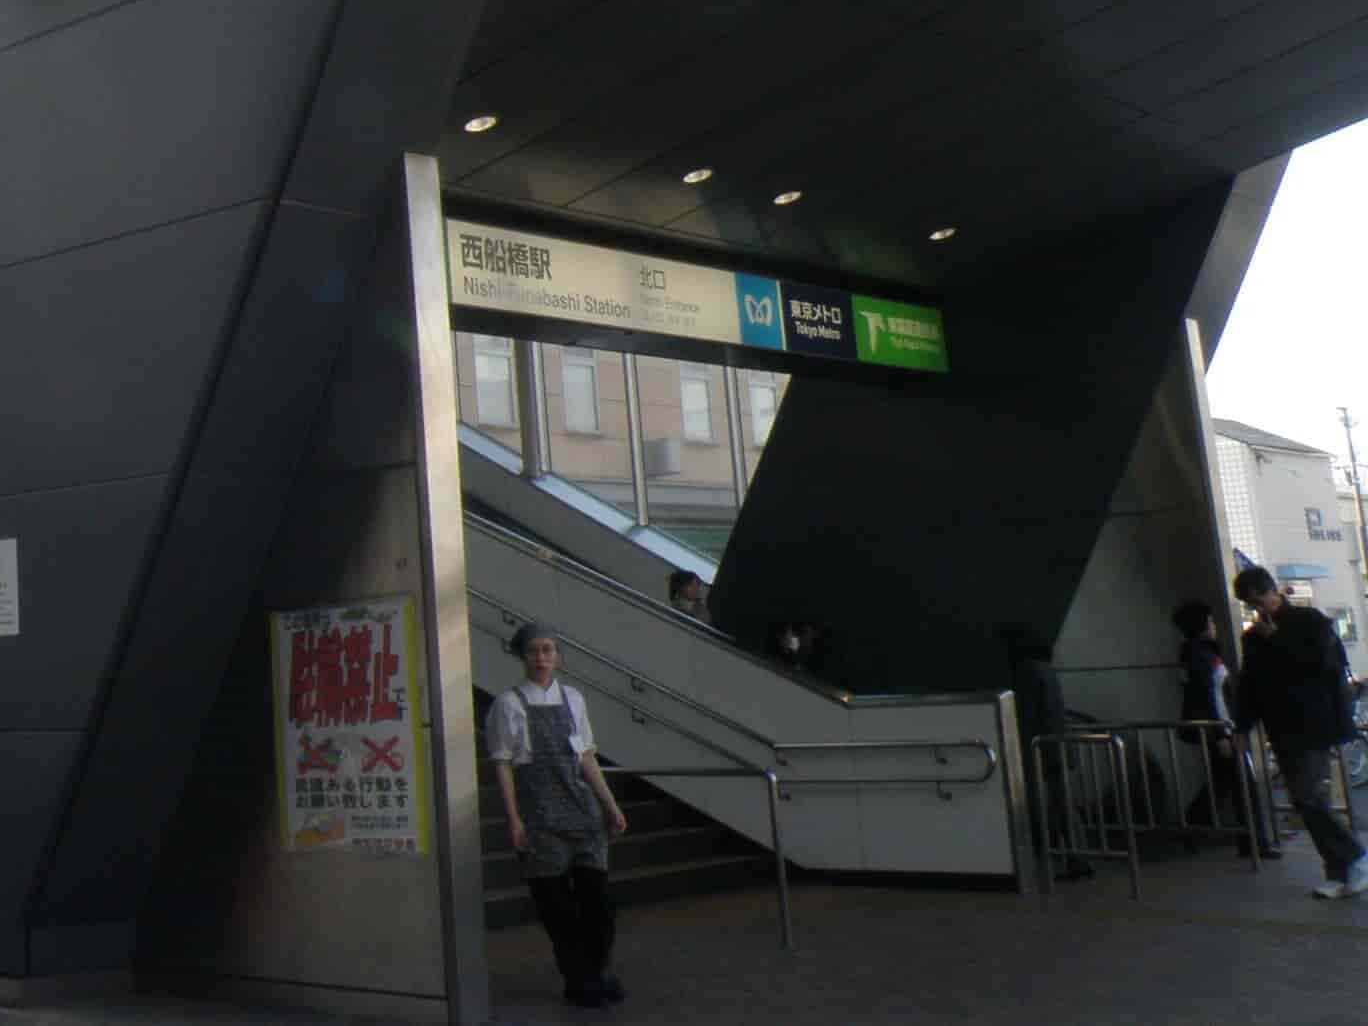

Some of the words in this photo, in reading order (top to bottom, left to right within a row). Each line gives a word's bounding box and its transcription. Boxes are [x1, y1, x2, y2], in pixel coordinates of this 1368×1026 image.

[460, 232, 553, 282] 西船橋駅
[639, 265, 666, 291] 北口
[584, 294, 631, 319] Station
[789, 299, 843, 325] 東京メトロ
